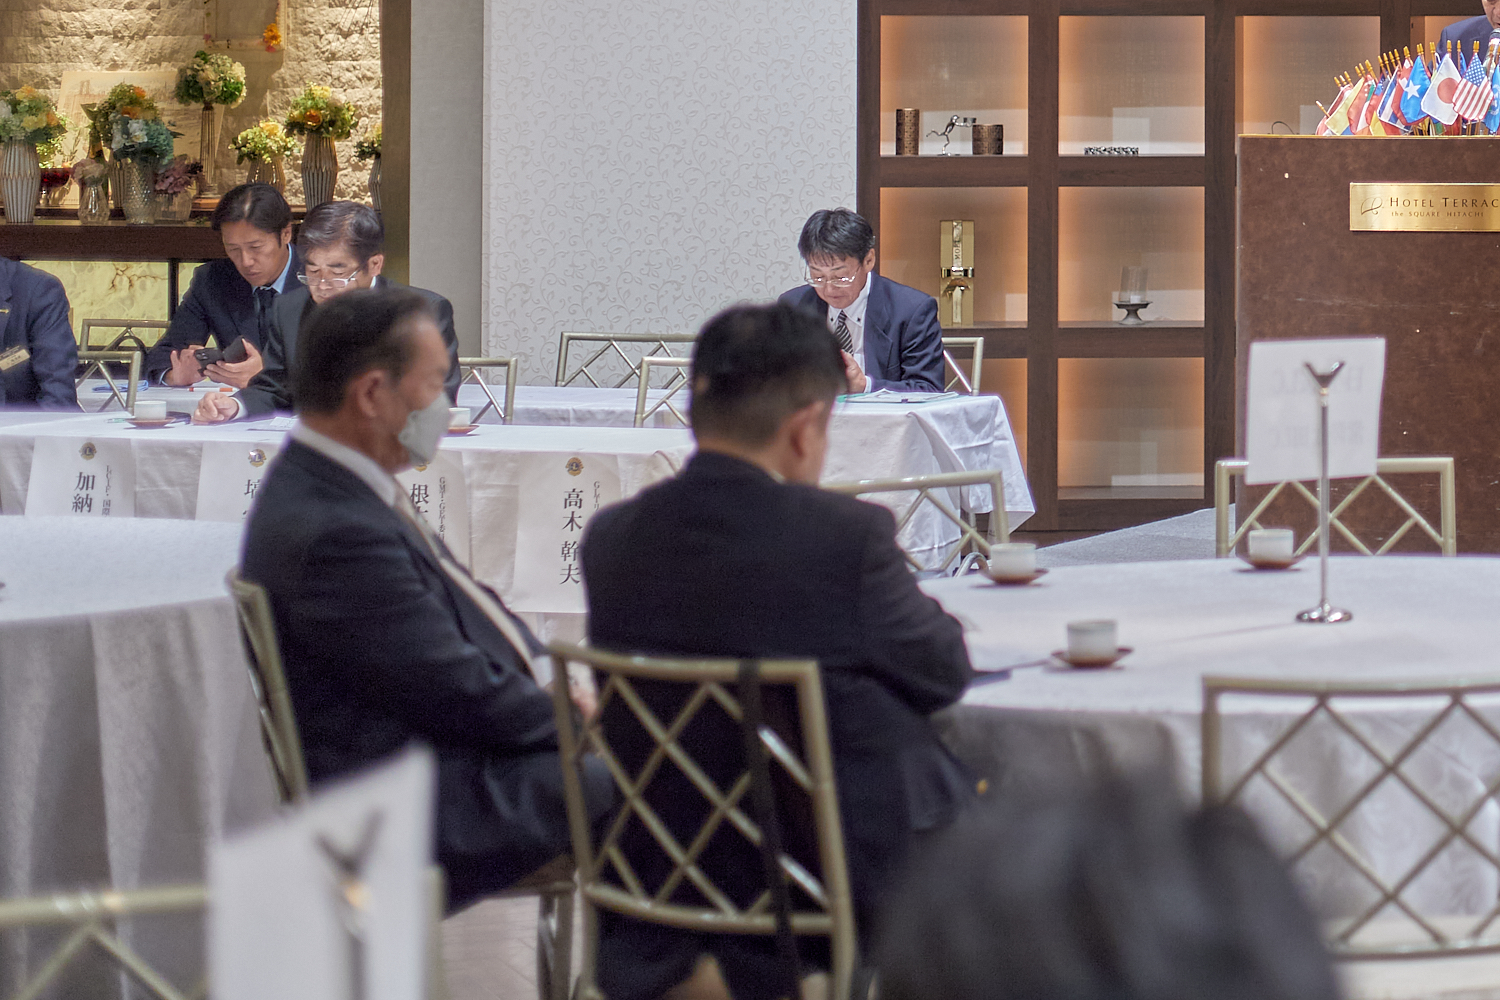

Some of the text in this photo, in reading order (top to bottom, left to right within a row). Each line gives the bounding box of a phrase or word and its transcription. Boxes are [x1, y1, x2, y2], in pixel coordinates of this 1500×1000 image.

[1390, 197, 1435, 208] HOTEL
[71, 471, 96, 514] 加納
[561, 488, 584, 533] 高木
